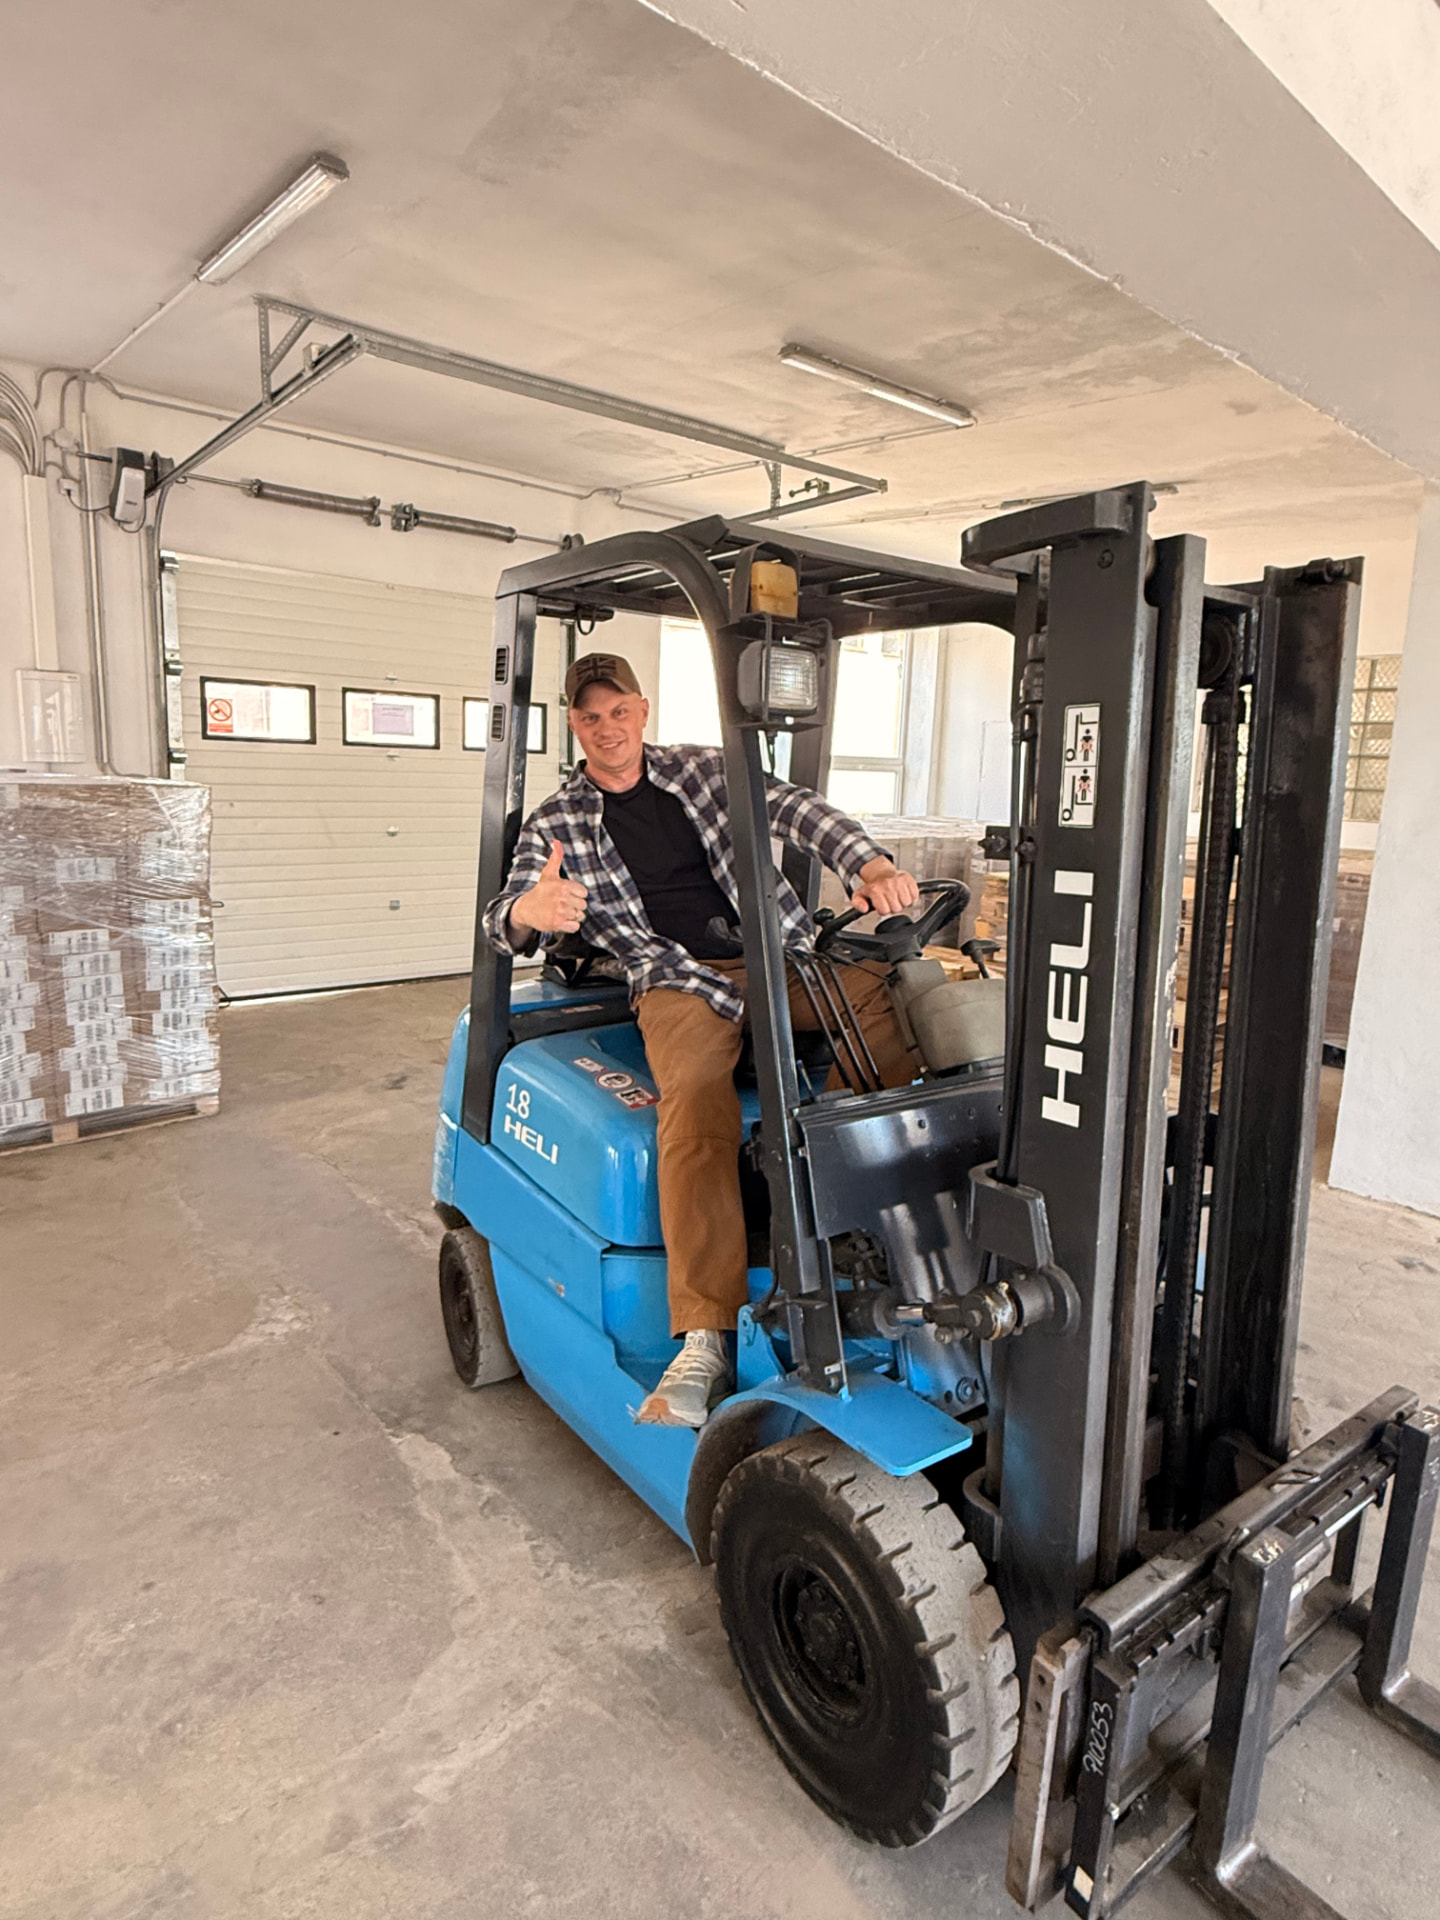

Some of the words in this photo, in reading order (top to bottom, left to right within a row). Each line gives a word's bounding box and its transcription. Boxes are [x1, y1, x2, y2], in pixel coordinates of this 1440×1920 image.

[1041, 869, 1095, 1129] HELI
[505, 1083, 531, 1119] 18
[503, 1114, 559, 1165] HELI
